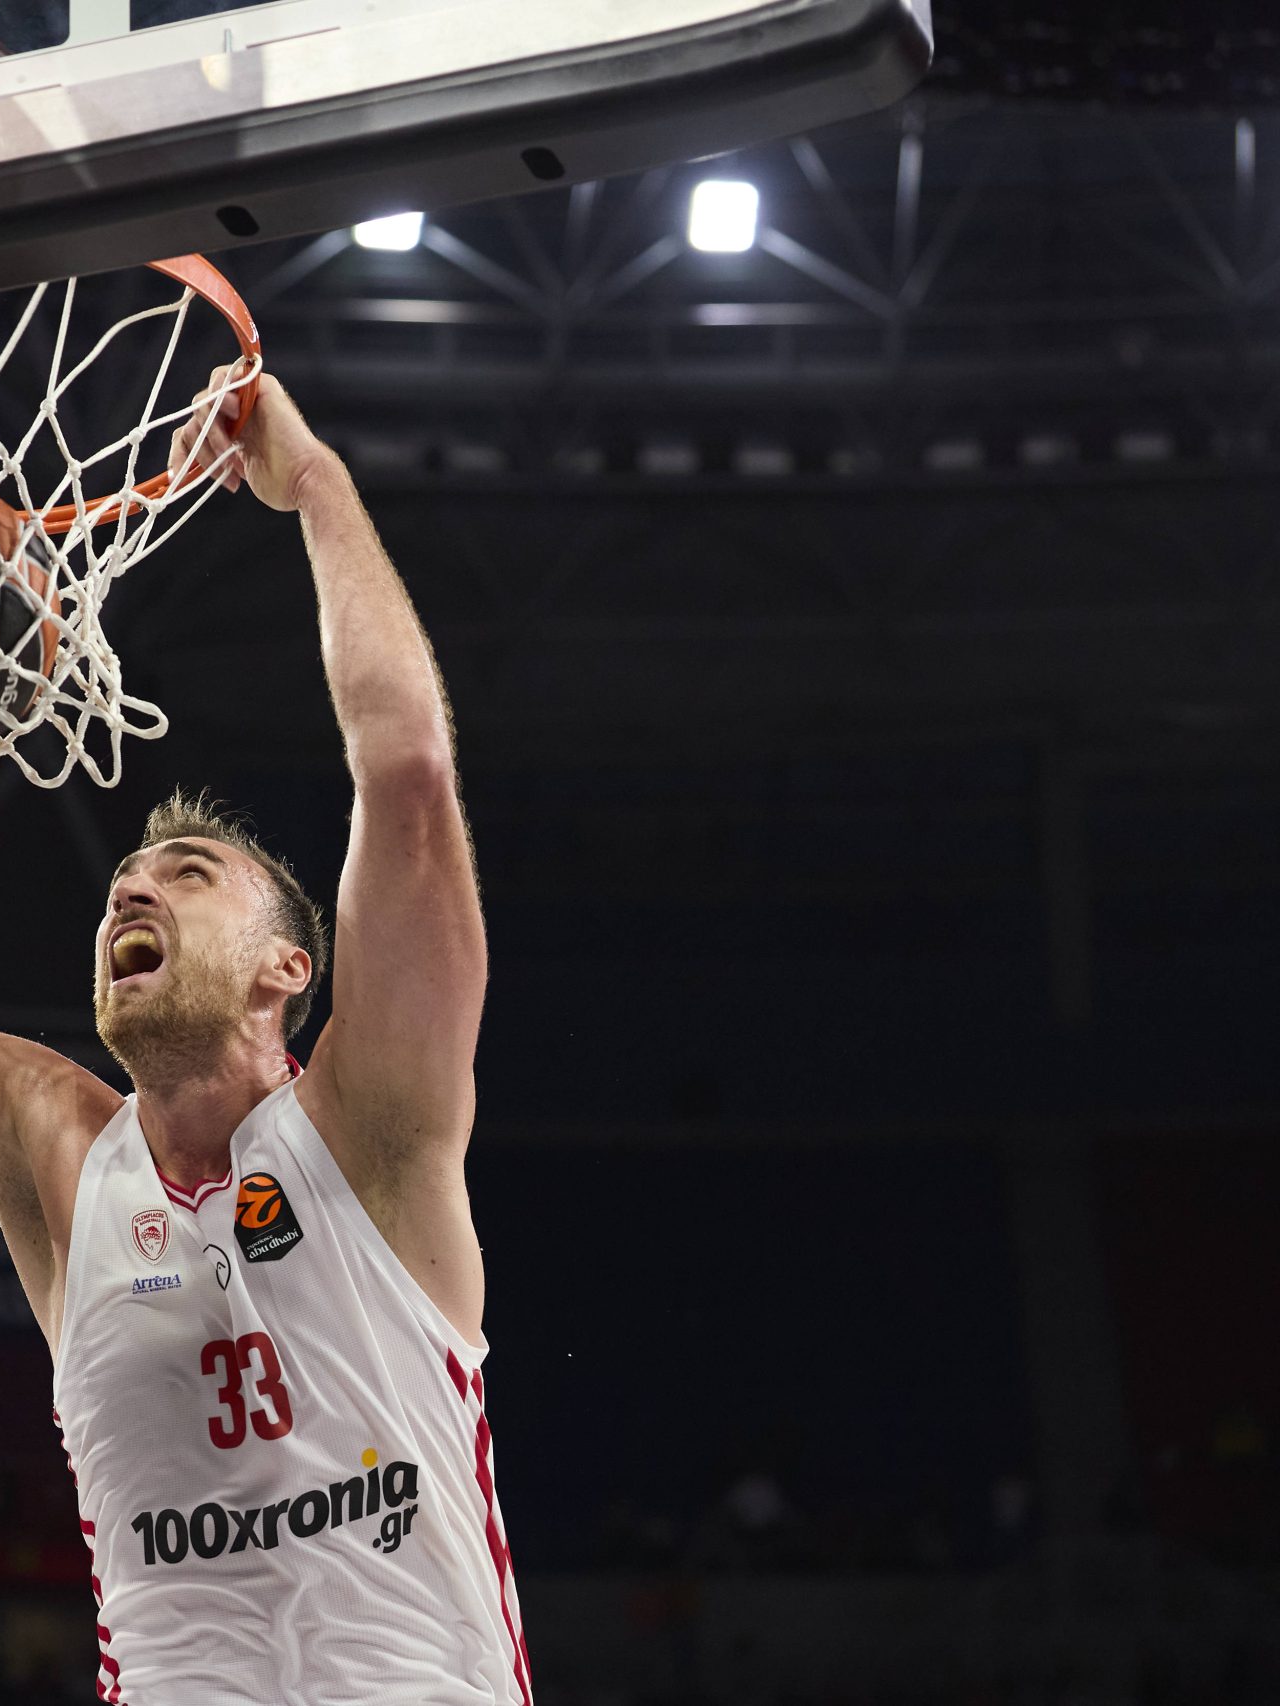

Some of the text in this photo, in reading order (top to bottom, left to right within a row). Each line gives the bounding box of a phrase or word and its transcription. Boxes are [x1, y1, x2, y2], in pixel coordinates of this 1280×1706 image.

[135, 1212, 165, 1223] OLYMPIACOS
[249, 1228, 299, 1259] abu dhabi
[200, 1331, 294, 1450] 33
[131, 1447, 419, 1566] 100xronia
[373, 1502, 419, 1554] .gr
